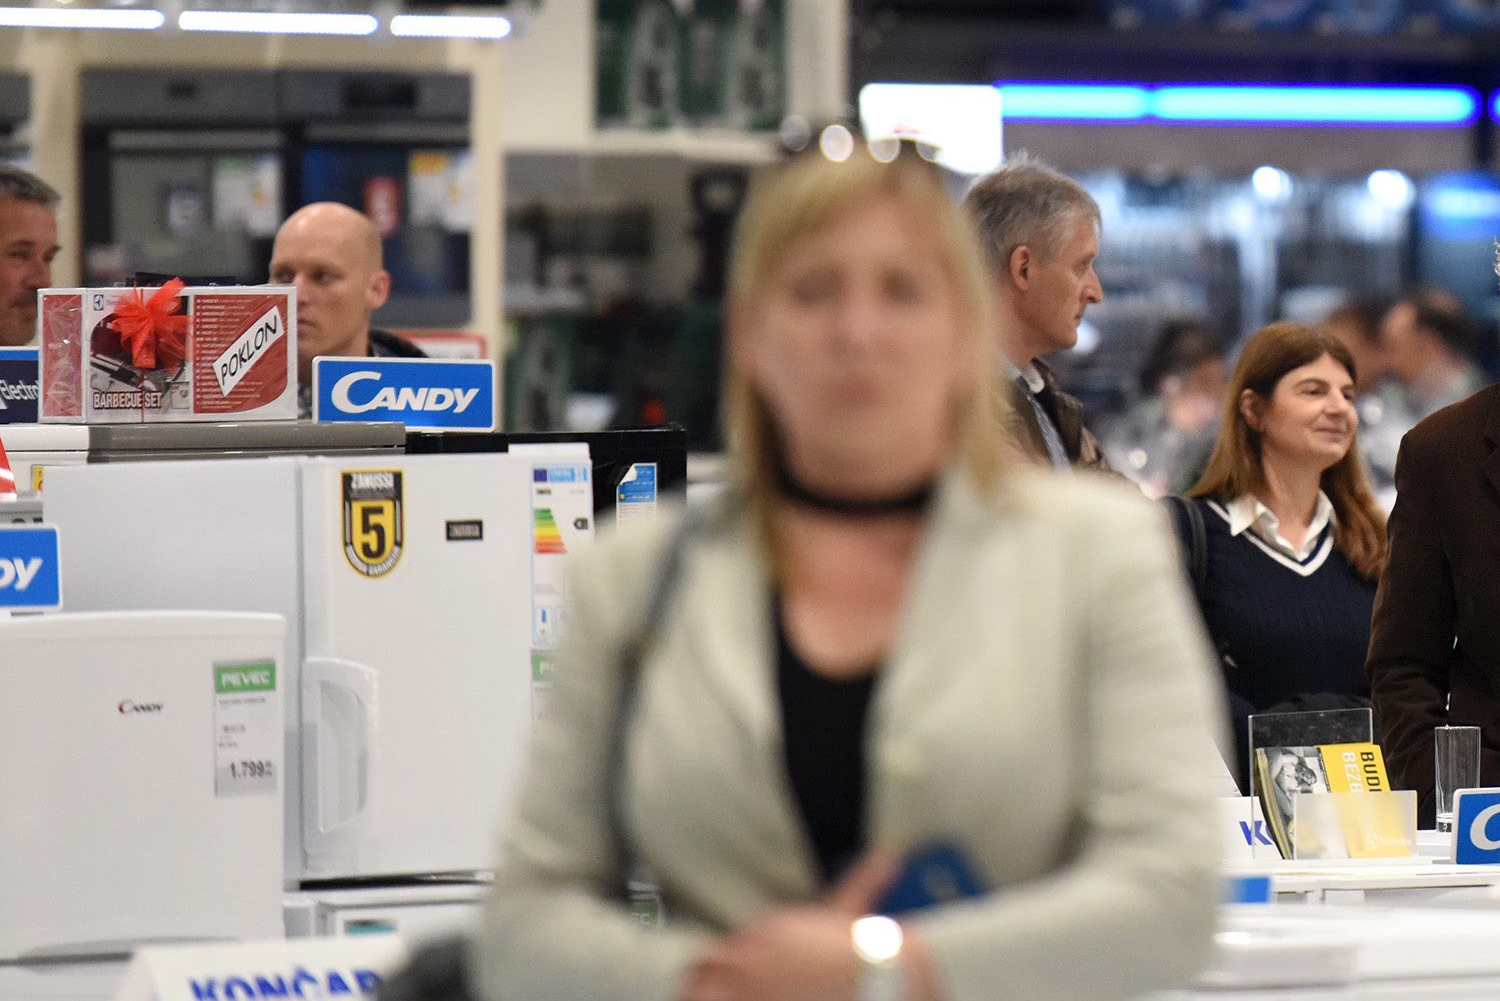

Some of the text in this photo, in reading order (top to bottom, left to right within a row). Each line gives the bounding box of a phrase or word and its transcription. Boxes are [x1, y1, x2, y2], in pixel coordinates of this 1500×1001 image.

[221, 315, 277, 386] POKLON
[93, 391, 162, 409] BARBECUE SET
[331, 371, 480, 413] CANDY
[362, 506, 385, 558] 5
[1360, 751, 1382, 793] BUDI
